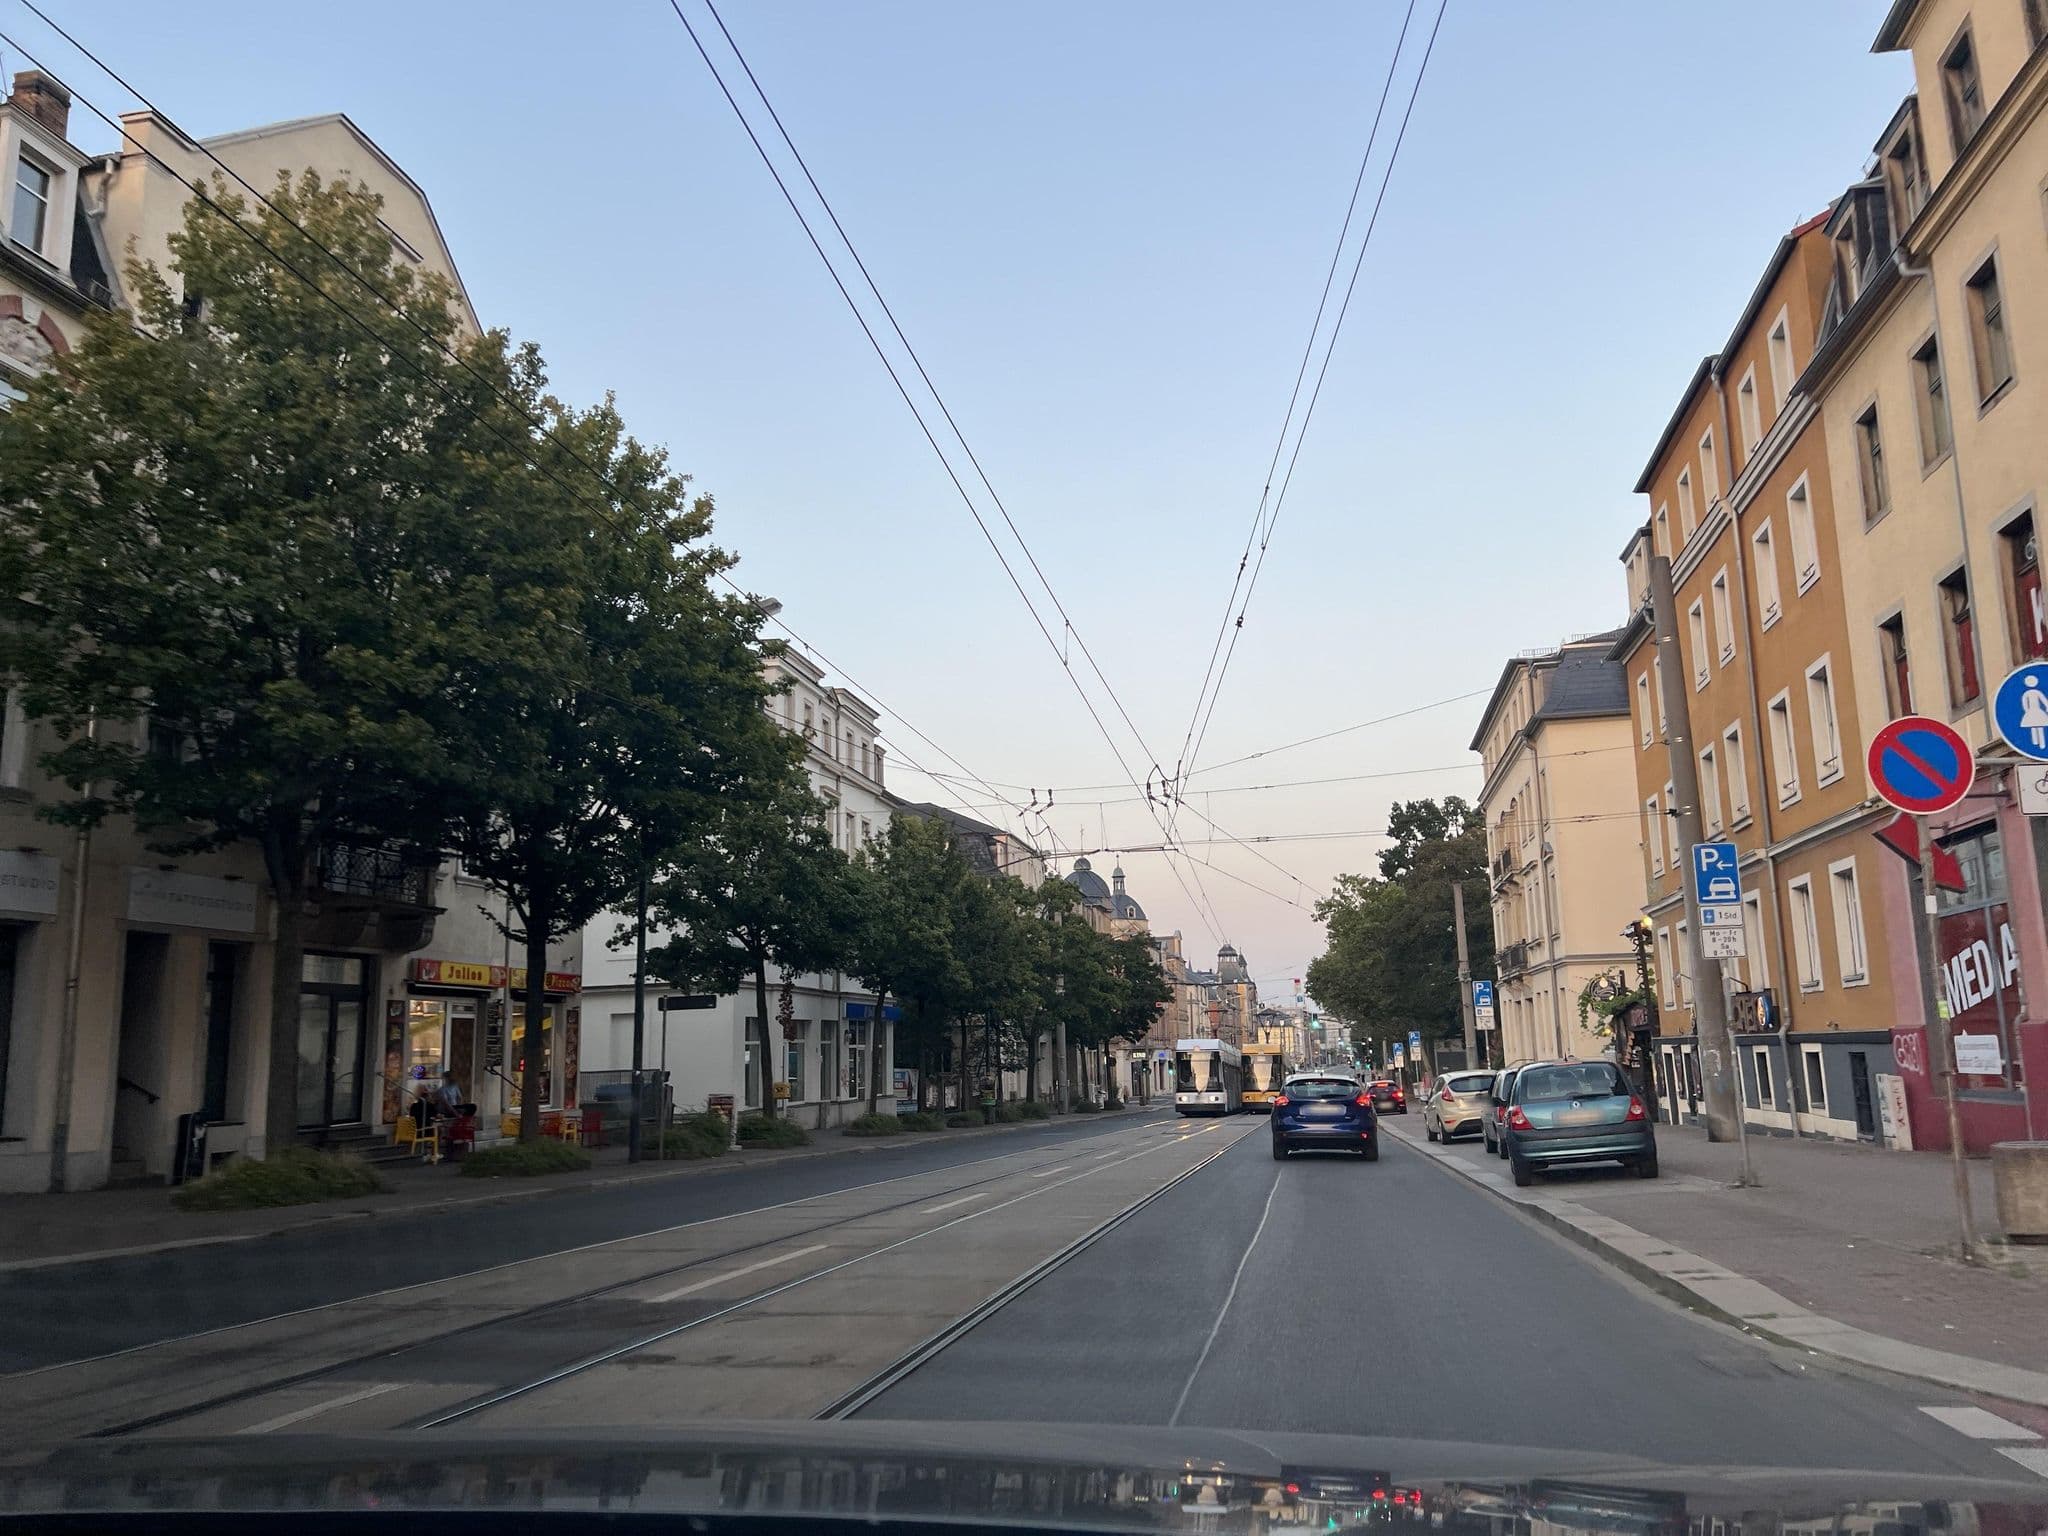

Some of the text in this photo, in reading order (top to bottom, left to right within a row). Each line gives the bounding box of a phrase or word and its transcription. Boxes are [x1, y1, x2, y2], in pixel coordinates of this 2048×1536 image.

[1700, 848, 1719, 872] P
[1718, 911, 1723, 919] 1
[1476, 982, 1484, 993] P
